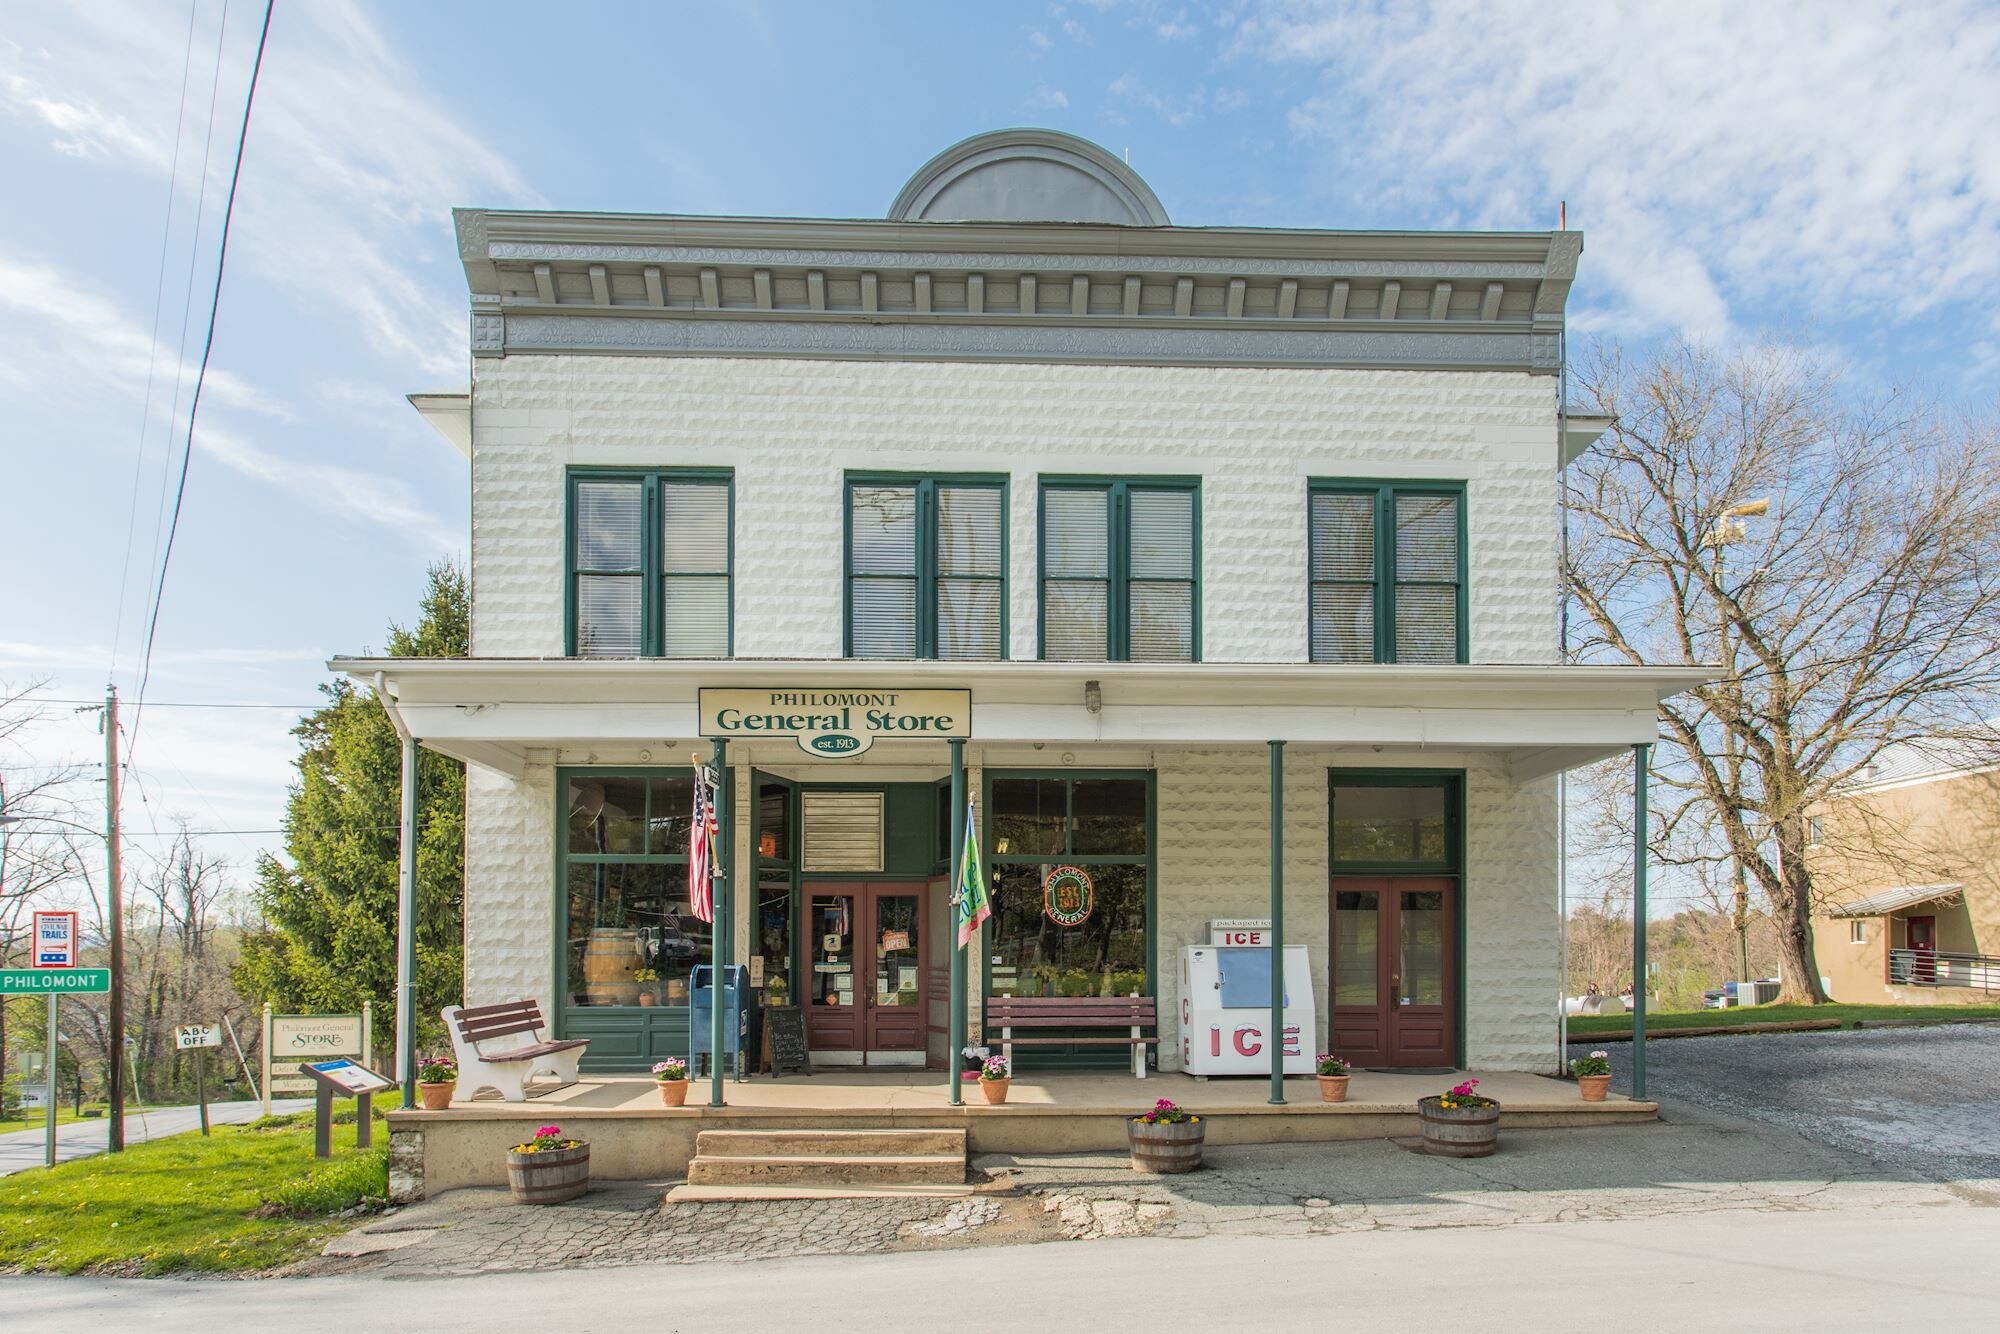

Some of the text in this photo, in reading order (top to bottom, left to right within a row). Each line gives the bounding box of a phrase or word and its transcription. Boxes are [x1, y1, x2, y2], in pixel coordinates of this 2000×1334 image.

[769, 692, 900, 707] PHILOMONT
[717, 707, 955, 732] General Store
[817, 738, 855, 750] est. 1913
[1047, 868, 1090, 894] PHILOMONT
[1048, 906, 1089, 924] GENERAL
[1216, 919, 1259, 927] packaged
[41, 930, 68, 940] TRAILS
[1225, 932, 1261, 945] ICE
[885, 939, 907, 950] OPEN
[3, 975, 99, 988] PHILOMONT
[281, 1023, 354, 1032] Philomont General
[183, 1036, 207, 1046] OFF
[292, 1033, 344, 1048] STORE
[1210, 1023, 1302, 1057] ICE
